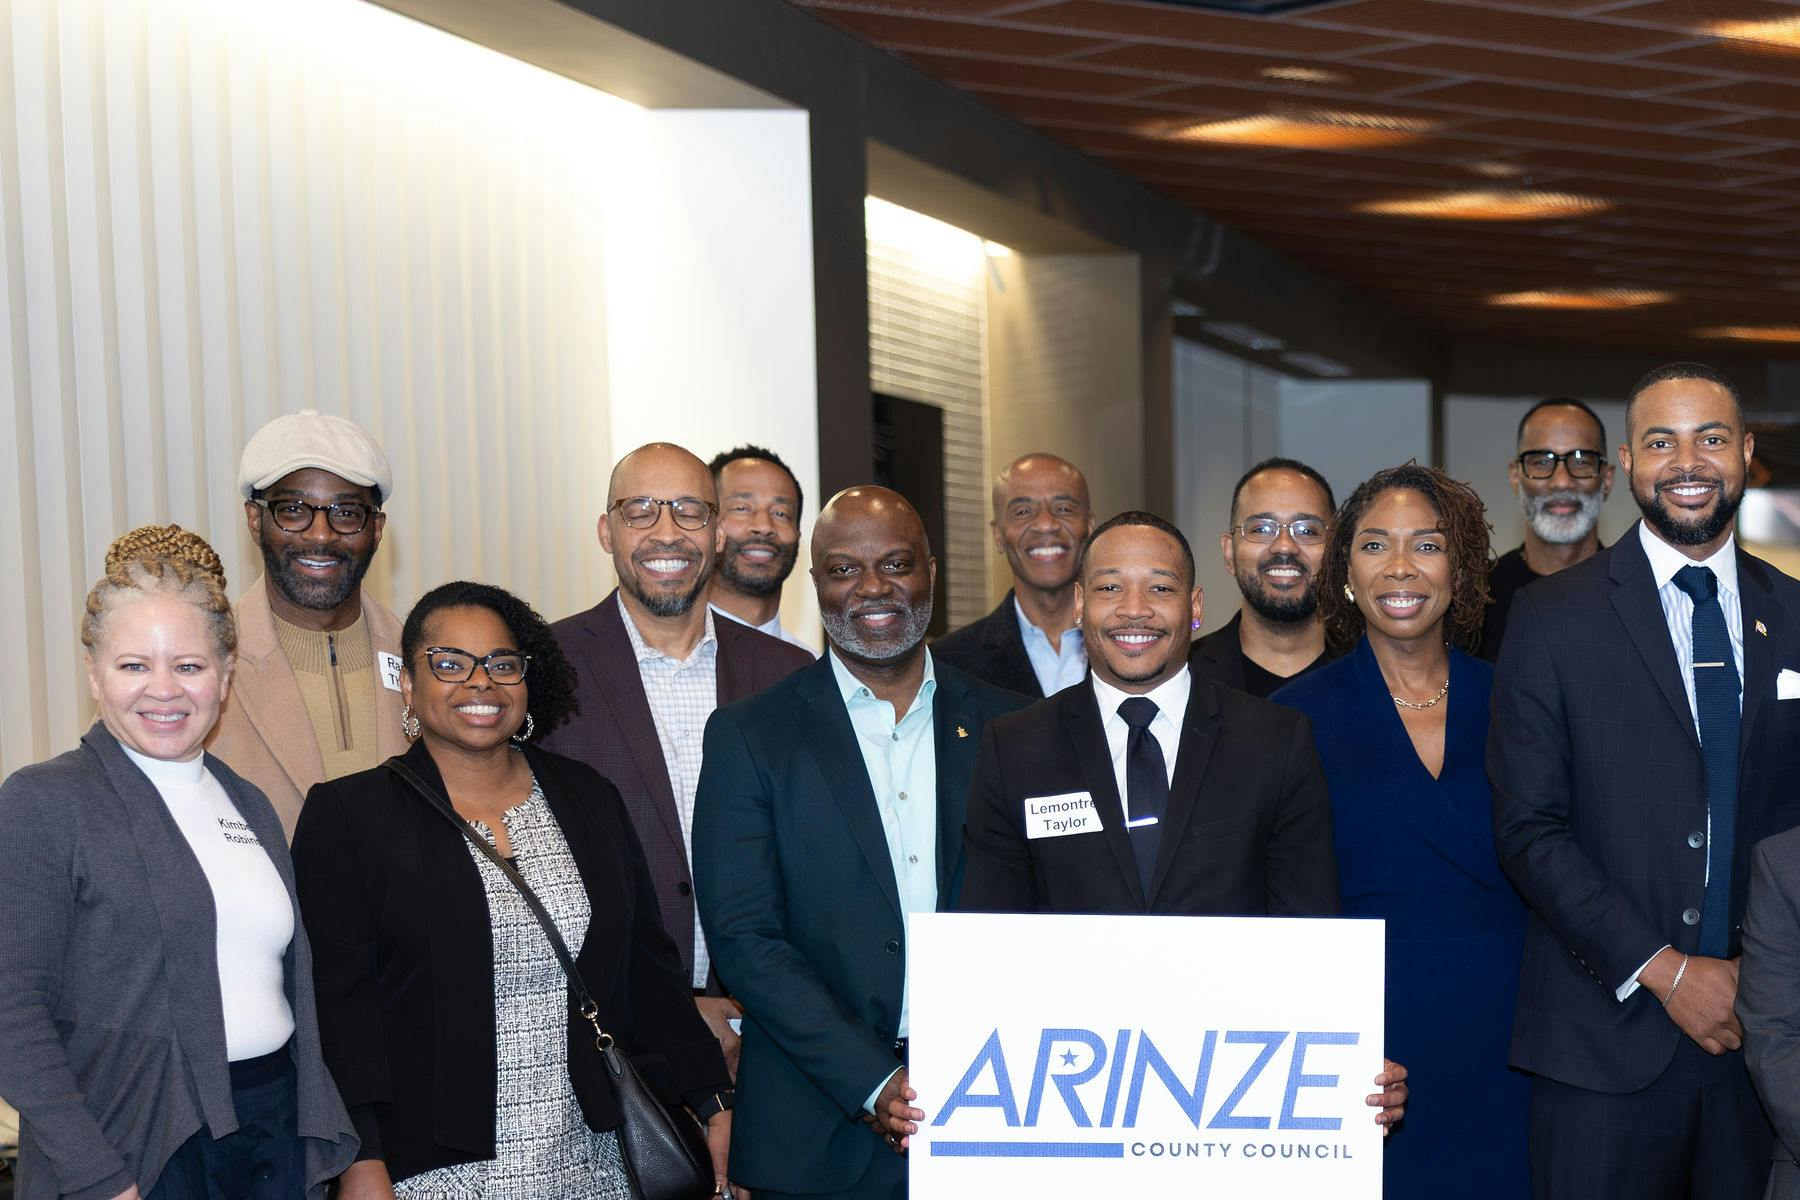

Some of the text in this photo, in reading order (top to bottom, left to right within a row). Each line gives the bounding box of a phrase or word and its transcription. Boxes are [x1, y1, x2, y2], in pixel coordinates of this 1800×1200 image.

[1043, 817, 1088, 832] Taylor
[931, 1027, 1360, 1131] ARINZE
[1131, 1142, 1353, 1159] COUNTY COUNCIL
